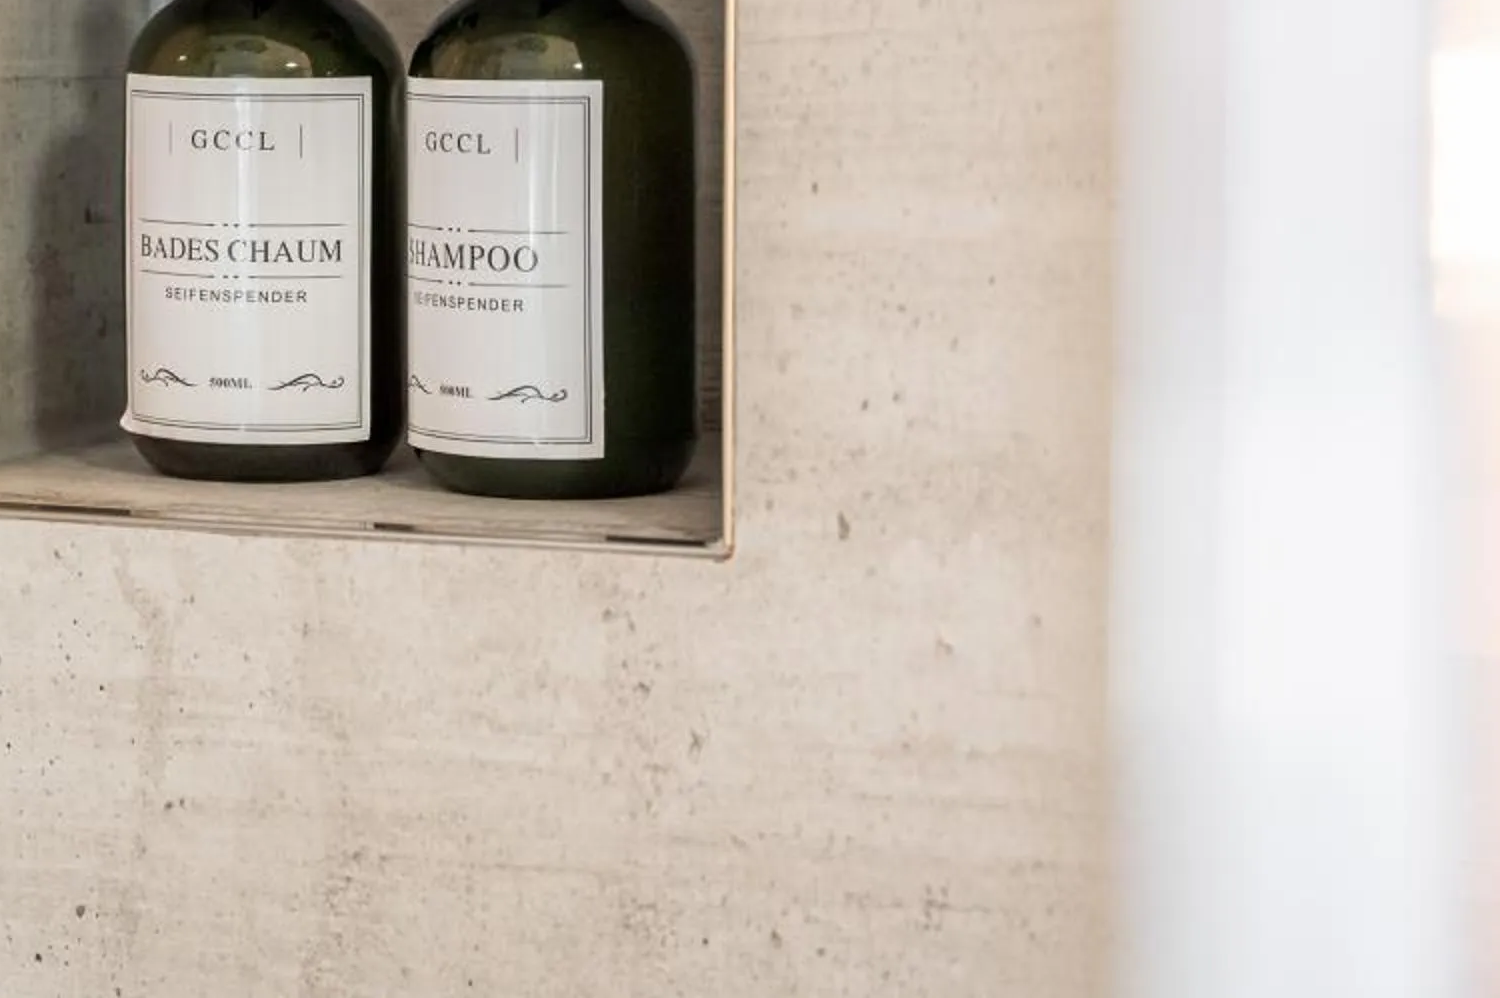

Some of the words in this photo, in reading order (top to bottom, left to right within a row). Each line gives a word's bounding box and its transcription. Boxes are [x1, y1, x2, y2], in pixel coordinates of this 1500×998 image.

[191, 129, 275, 151] GCCL
[425, 131, 491, 154] GCCL
[407, 236, 539, 273] SHAMPOO
[165, 287, 308, 304] SEIFENSPENDER
